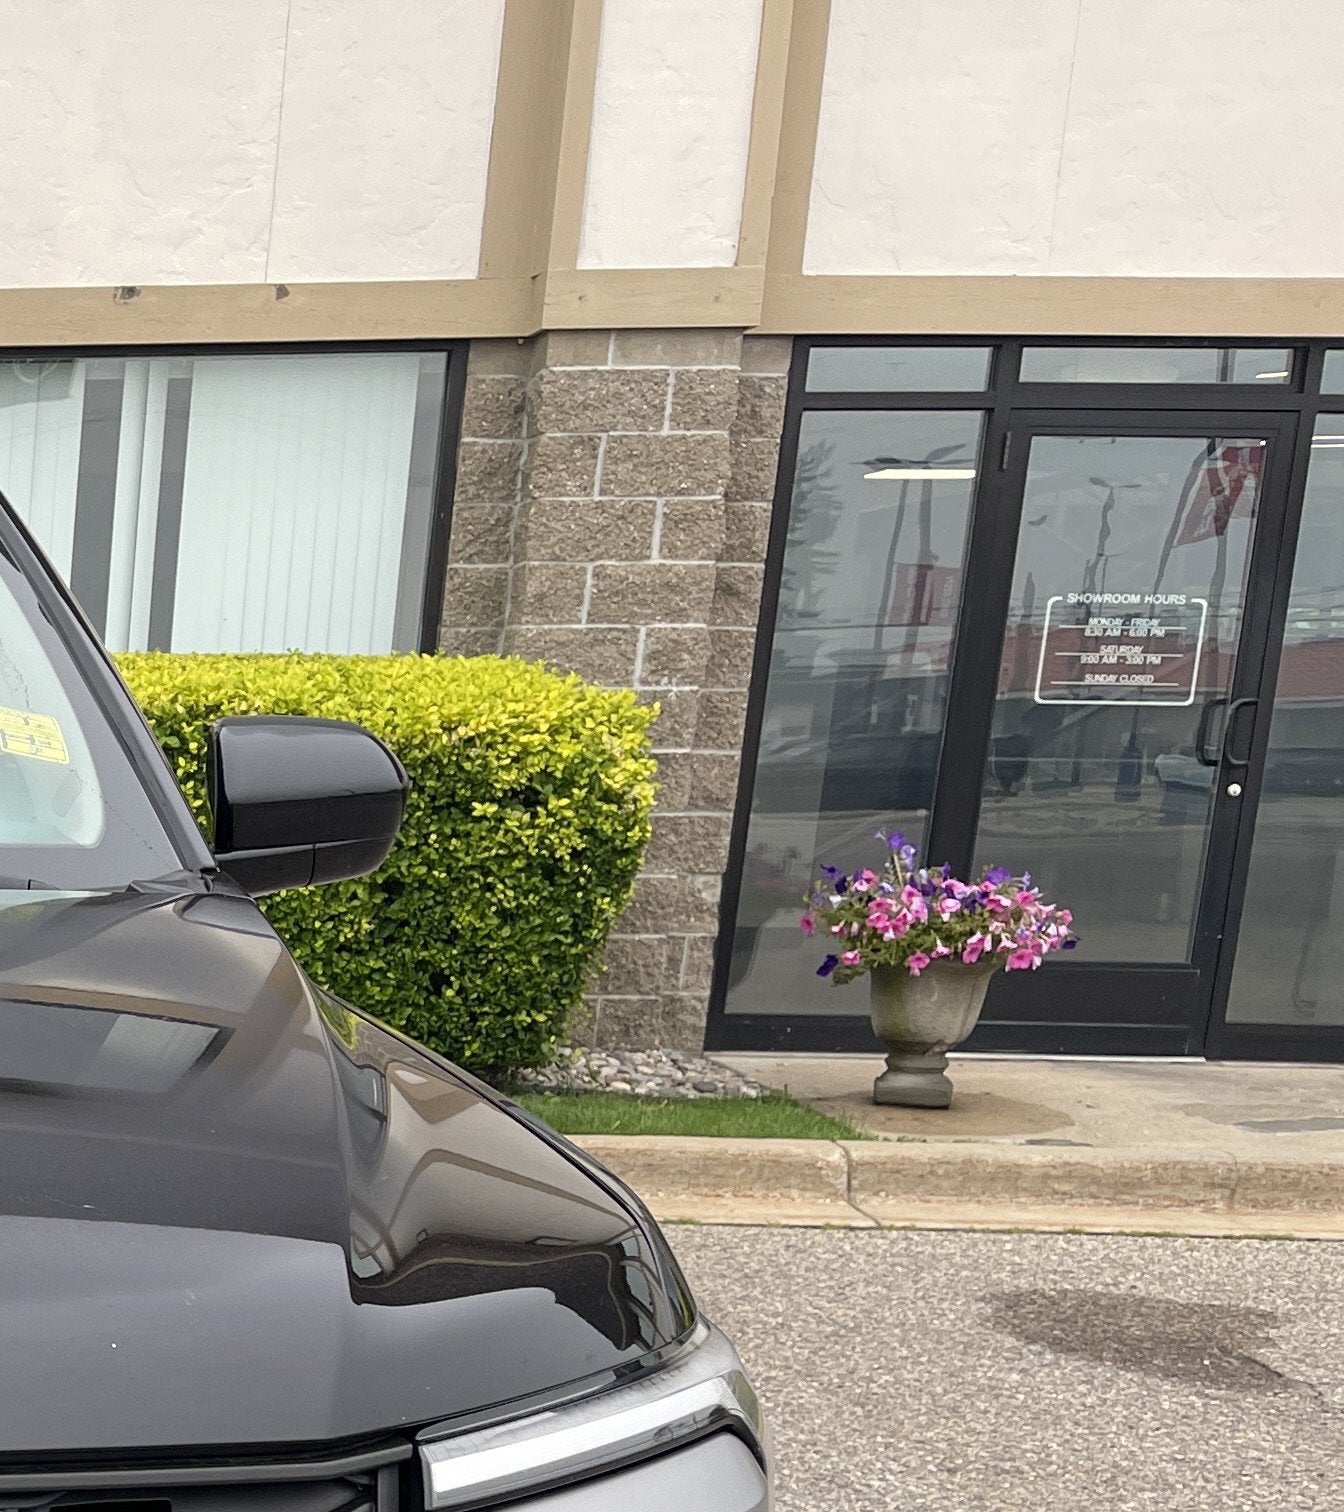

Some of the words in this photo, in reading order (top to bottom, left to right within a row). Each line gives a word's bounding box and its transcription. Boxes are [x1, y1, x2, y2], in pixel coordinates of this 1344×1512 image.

[1067, 593, 1140, 604] SHOWROOM
[1144, 594, 1187, 605] HOURS
[1088, 617, 1125, 627] MONDAY
[1130, 617, 1161, 627] FRIDAY
[1104, 627, 1121, 637] AM
[1150, 627, 1166, 638] PM
[1099, 645, 1144, 654] SATURDAY
[1101, 655, 1118, 664] AM
[1146, 655, 1162, 665] PM
[1085, 673, 1119, 682] SUNDAY
[1119, 674, 1155, 683] CLOSED
